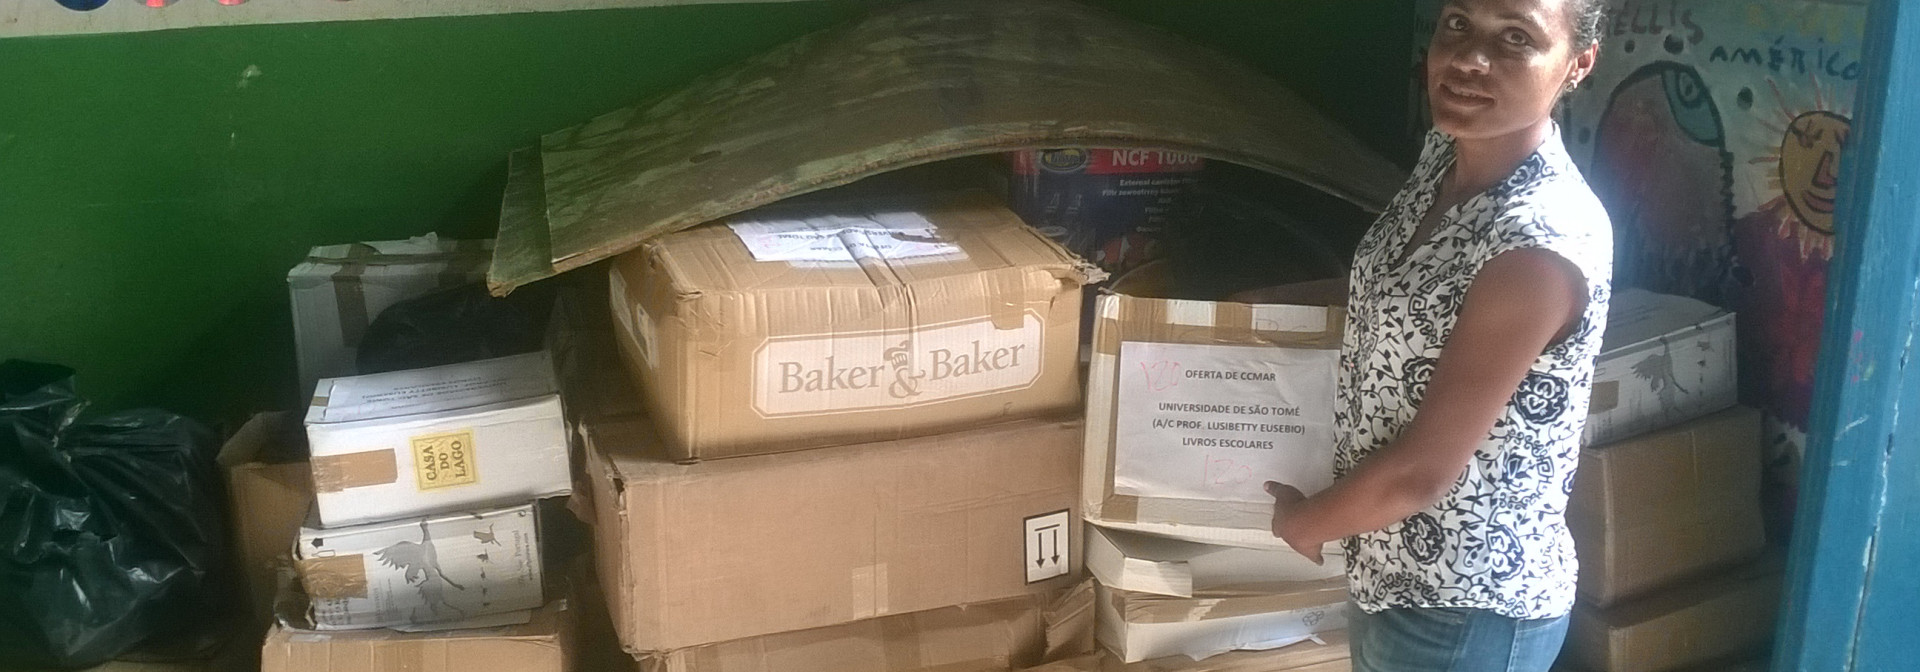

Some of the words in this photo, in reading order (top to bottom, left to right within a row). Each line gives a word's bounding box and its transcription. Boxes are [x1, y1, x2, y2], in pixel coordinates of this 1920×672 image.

[1112, 150, 1149, 167] NCF
[1156, 151, 1199, 165] 1000
[778, 355, 886, 394] Baker
[887, 365, 927, 399] &
[928, 340, 1026, 382] Baker
[1185, 369, 1223, 380] OFERTA
[1225, 370, 1239, 380] DE
[1240, 371, 1276, 382] CCMAR
[1158, 402, 1230, 414] UNIVERSIDADE
[1233, 405, 1246, 414] DE
[1248, 404, 1269, 416] SÃO
[1272, 405, 1301, 417] TOMÉ
[1152, 418, 1174, 430] (A/C
[1176, 420, 1205, 430] PROF.
[1207, 422, 1258, 432] LUSIBETTY
[1260, 423, 1306, 435] EUSEBIO)
[1182, 437, 1217, 447] LIVROS
[1219, 438, 1274, 450] ESCOLARES
[422, 445, 437, 481] CASA
[438, 452, 450, 471] DO
[450, 440, 466, 478] LAGO
